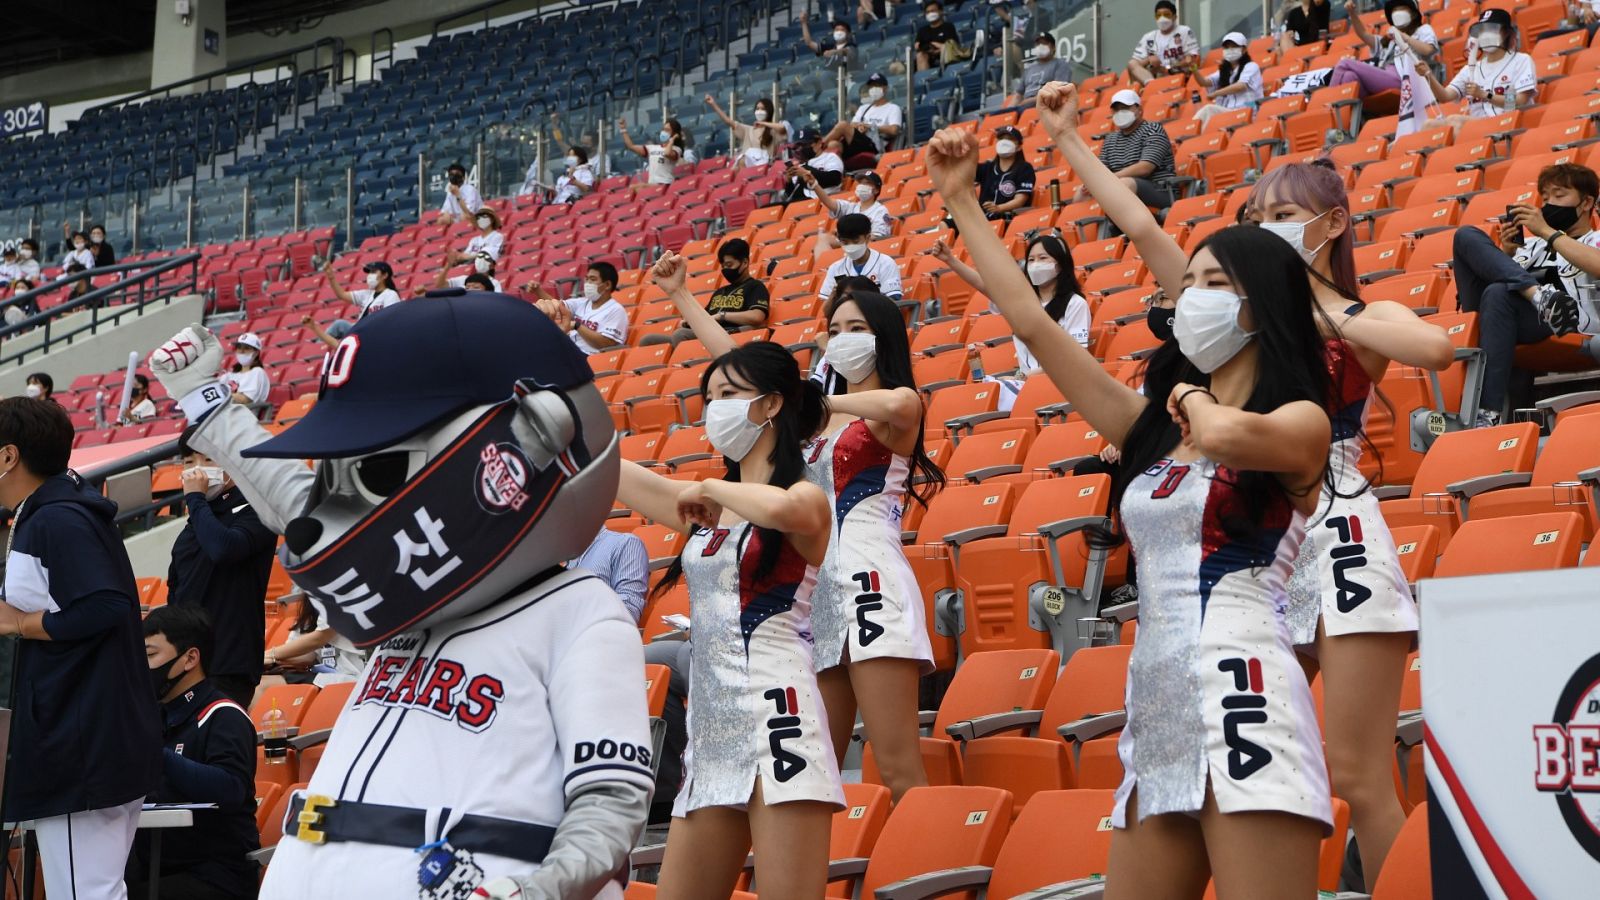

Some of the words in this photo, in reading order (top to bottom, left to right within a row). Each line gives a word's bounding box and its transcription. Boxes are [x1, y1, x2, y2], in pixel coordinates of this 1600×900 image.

[1430, 415, 1444, 425] 206
[1150, 464, 1191, 500] D
[317, 505, 463, 631] 두산
[1325, 514, 1372, 614] FILA
[1540, 533, 1552, 543] 36
[852, 570, 885, 648] FILA
[1047, 590, 1062, 601] 206
[763, 686, 807, 783] FILA
[1218, 656, 1273, 781] FILA
[574, 738, 652, 770] DOOS
[1533, 724, 1600, 793] BE
